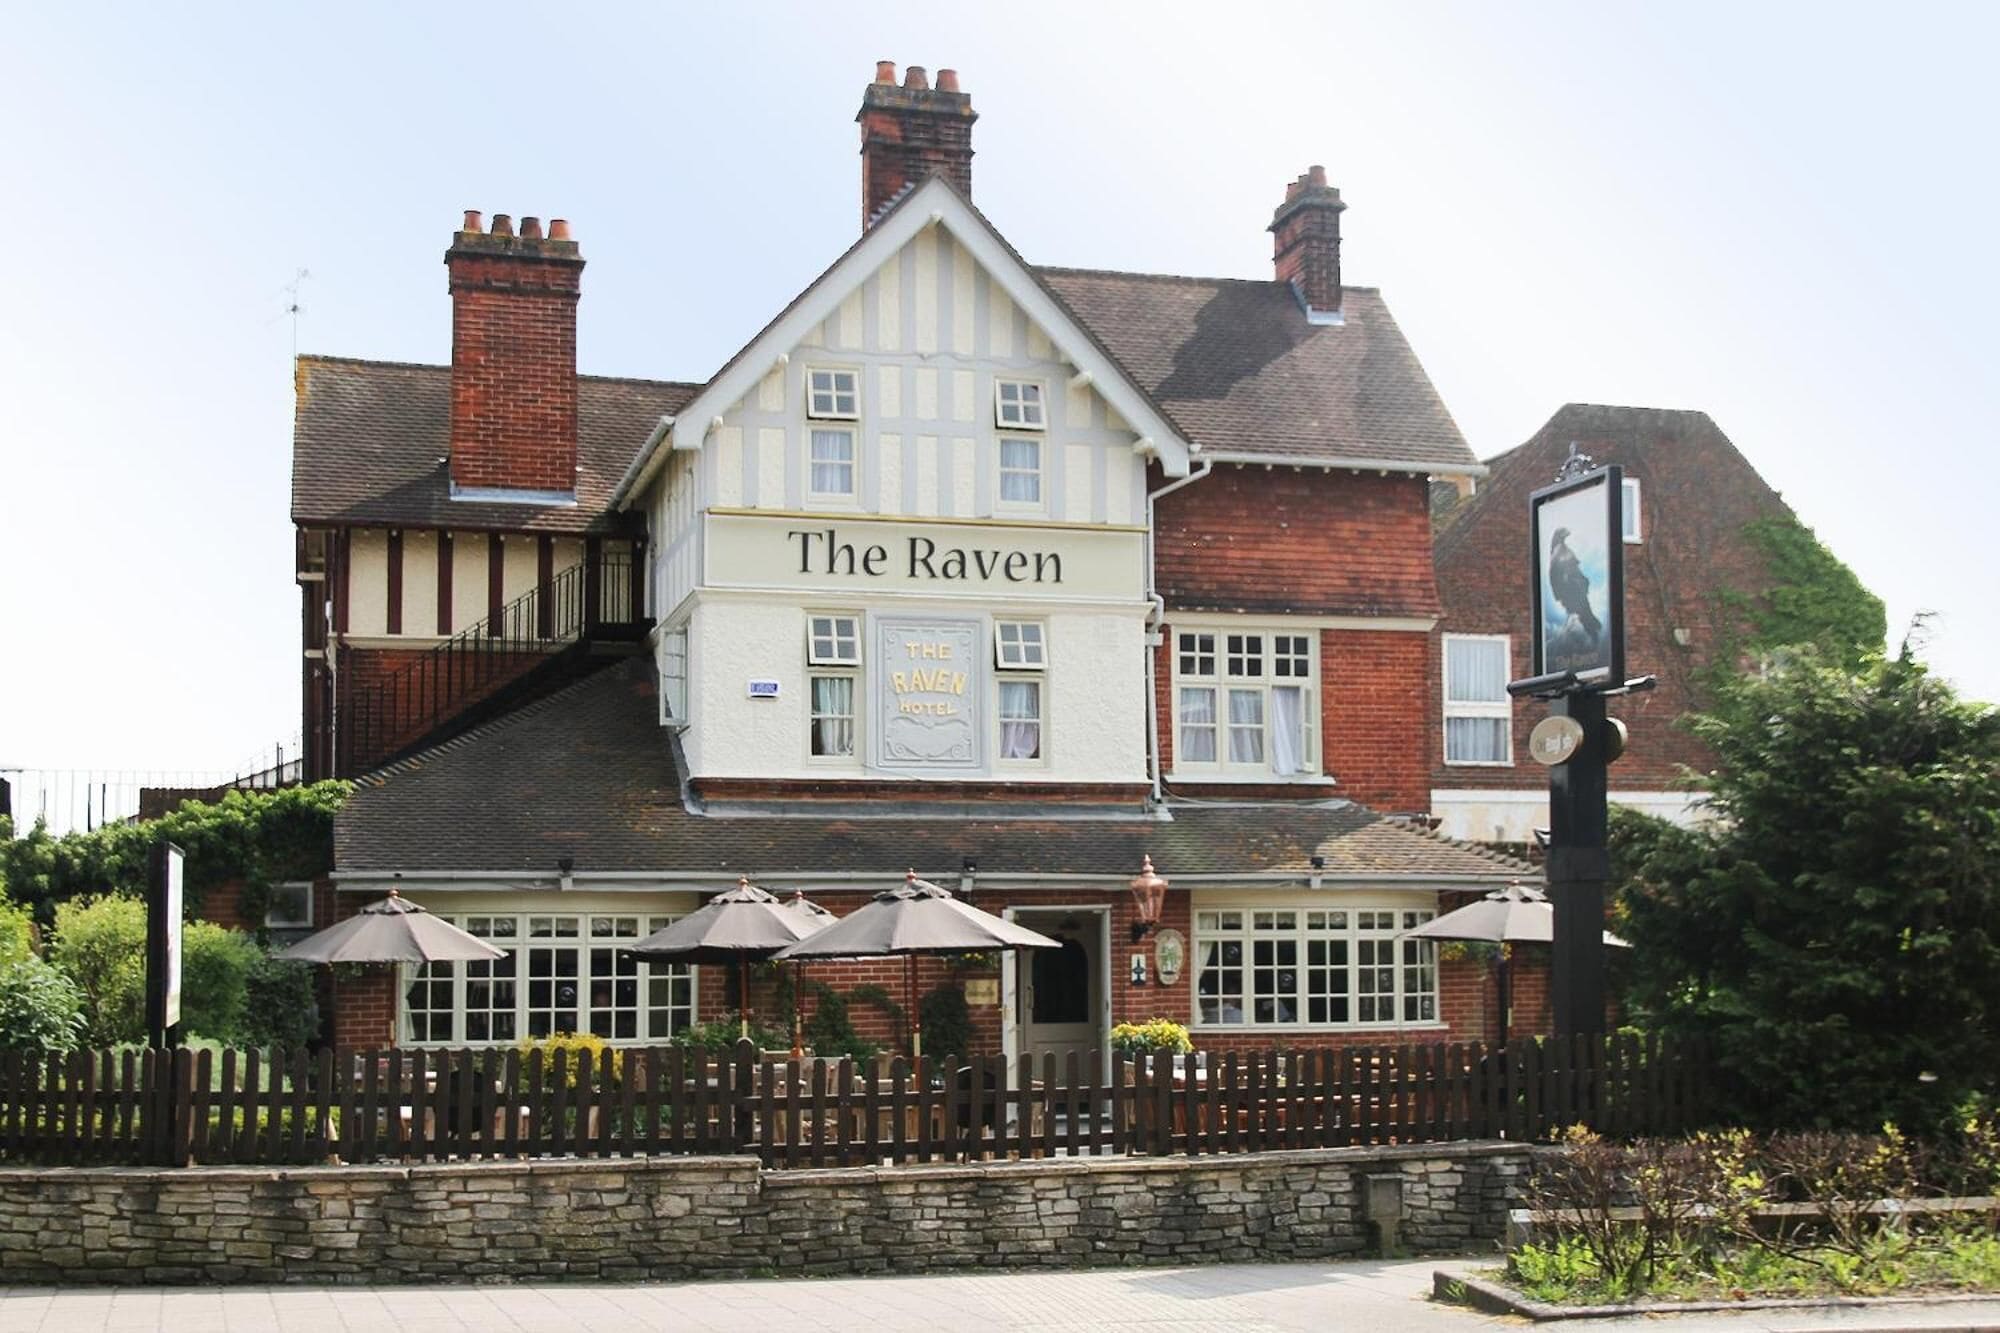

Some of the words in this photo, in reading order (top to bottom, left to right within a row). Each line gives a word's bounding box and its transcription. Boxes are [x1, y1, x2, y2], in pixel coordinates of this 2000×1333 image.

[788, 530, 887, 576] The
[908, 536, 1063, 583] Raven
[906, 641, 952, 659] THE
[893, 669, 967, 695] RAVEN
[900, 702, 957, 715] HOTEL
